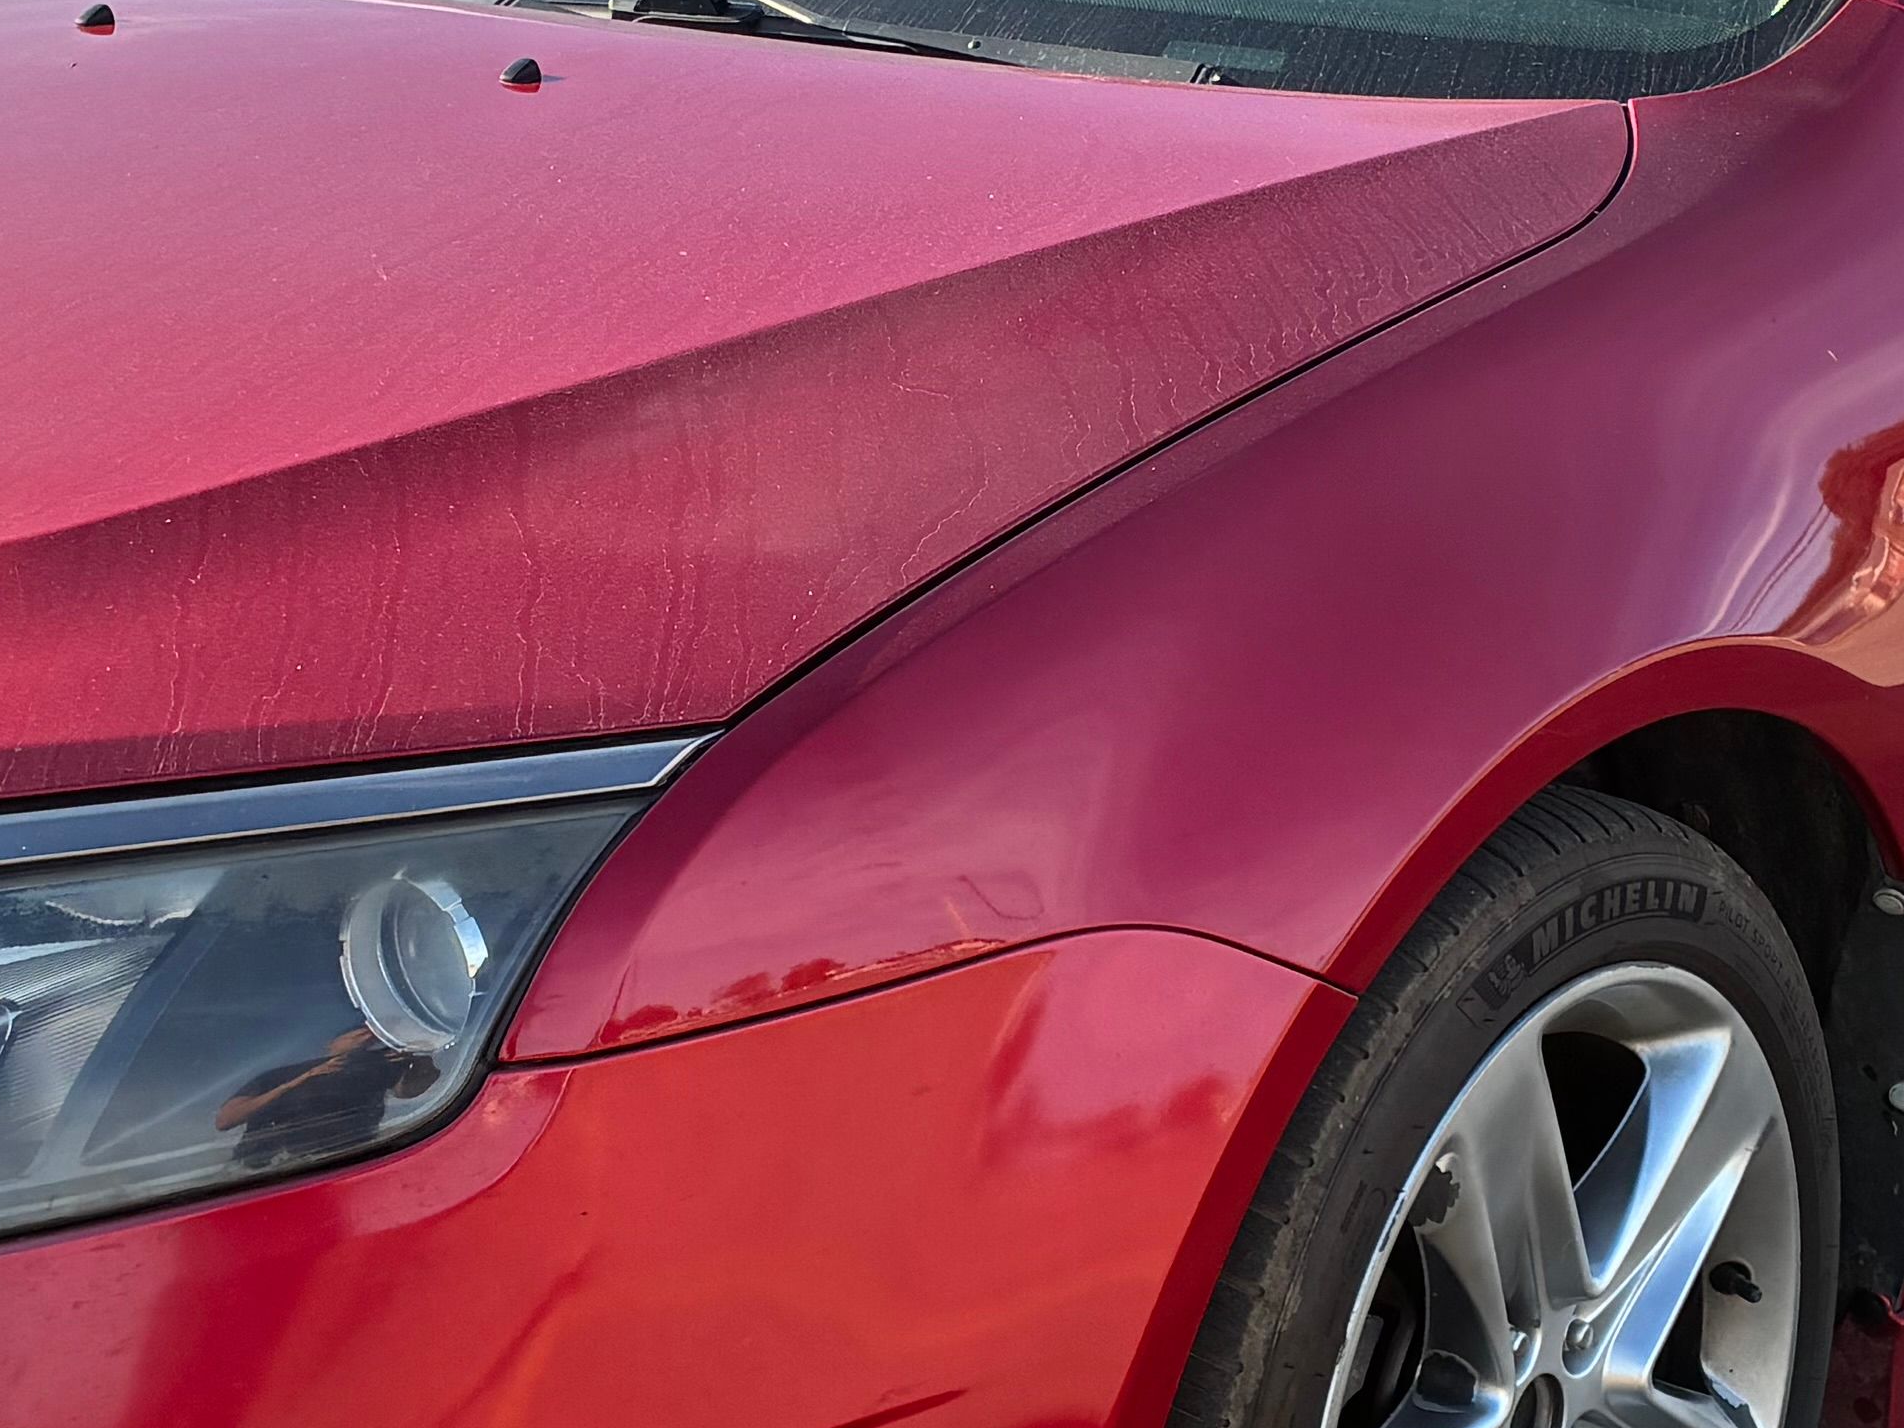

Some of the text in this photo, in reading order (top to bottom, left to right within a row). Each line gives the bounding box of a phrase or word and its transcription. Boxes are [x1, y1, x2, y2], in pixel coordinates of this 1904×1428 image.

[1531, 879, 1698, 962] MICHELIN
[1718, 900, 1751, 933] PILOT
[1751, 928, 1784, 976] SPORT
